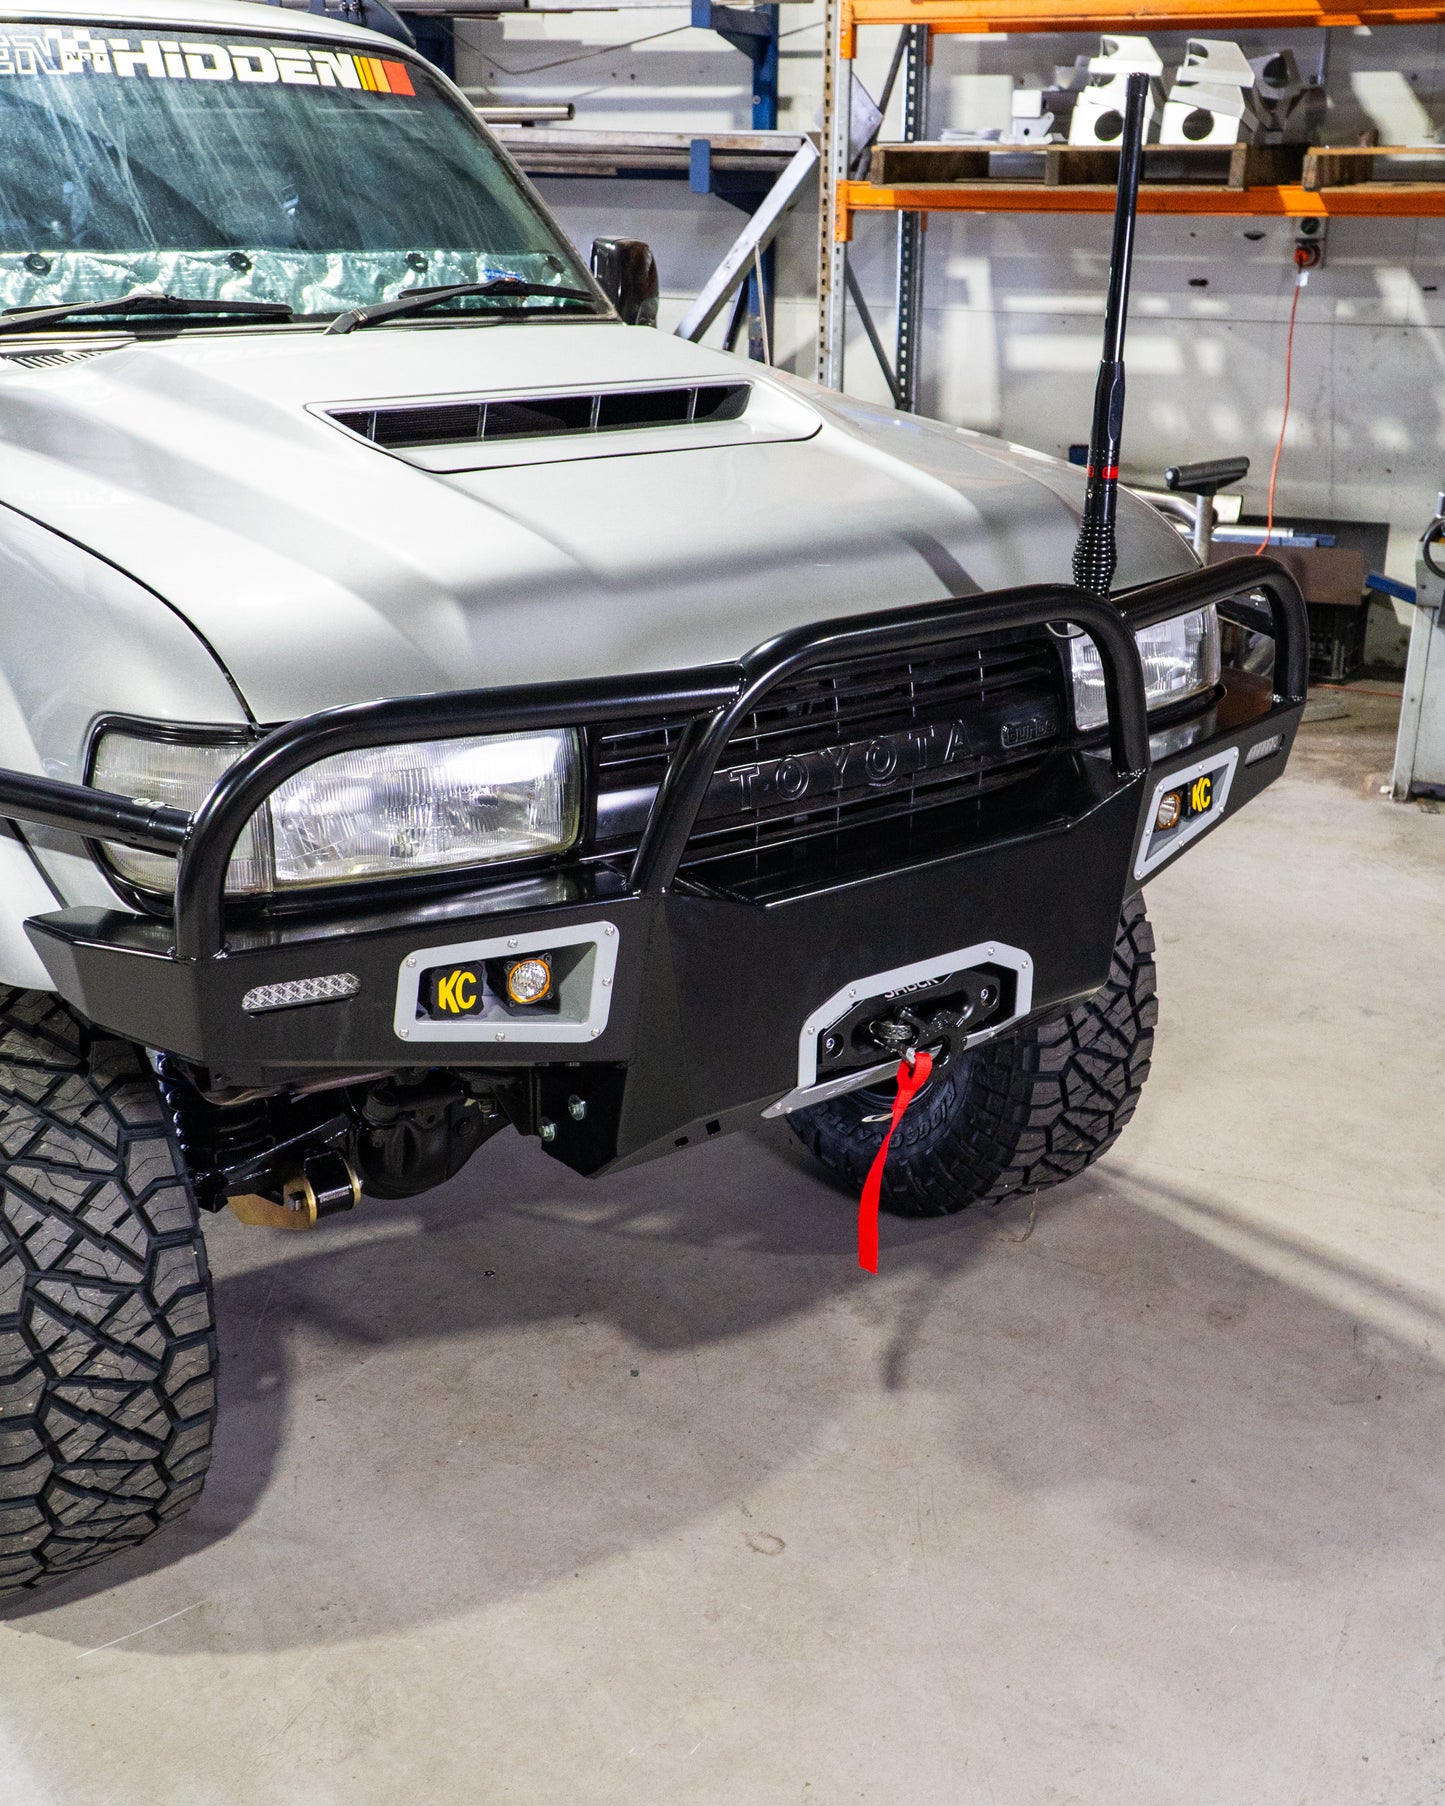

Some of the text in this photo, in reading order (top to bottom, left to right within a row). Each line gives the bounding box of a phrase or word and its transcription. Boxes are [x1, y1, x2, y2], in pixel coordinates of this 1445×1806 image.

[108, 38, 362, 90] HIDDEN
[727, 719, 974, 811] TOYOTA
[1191, 777, 1211, 812] KC
[438, 970, 476, 1013] KC
